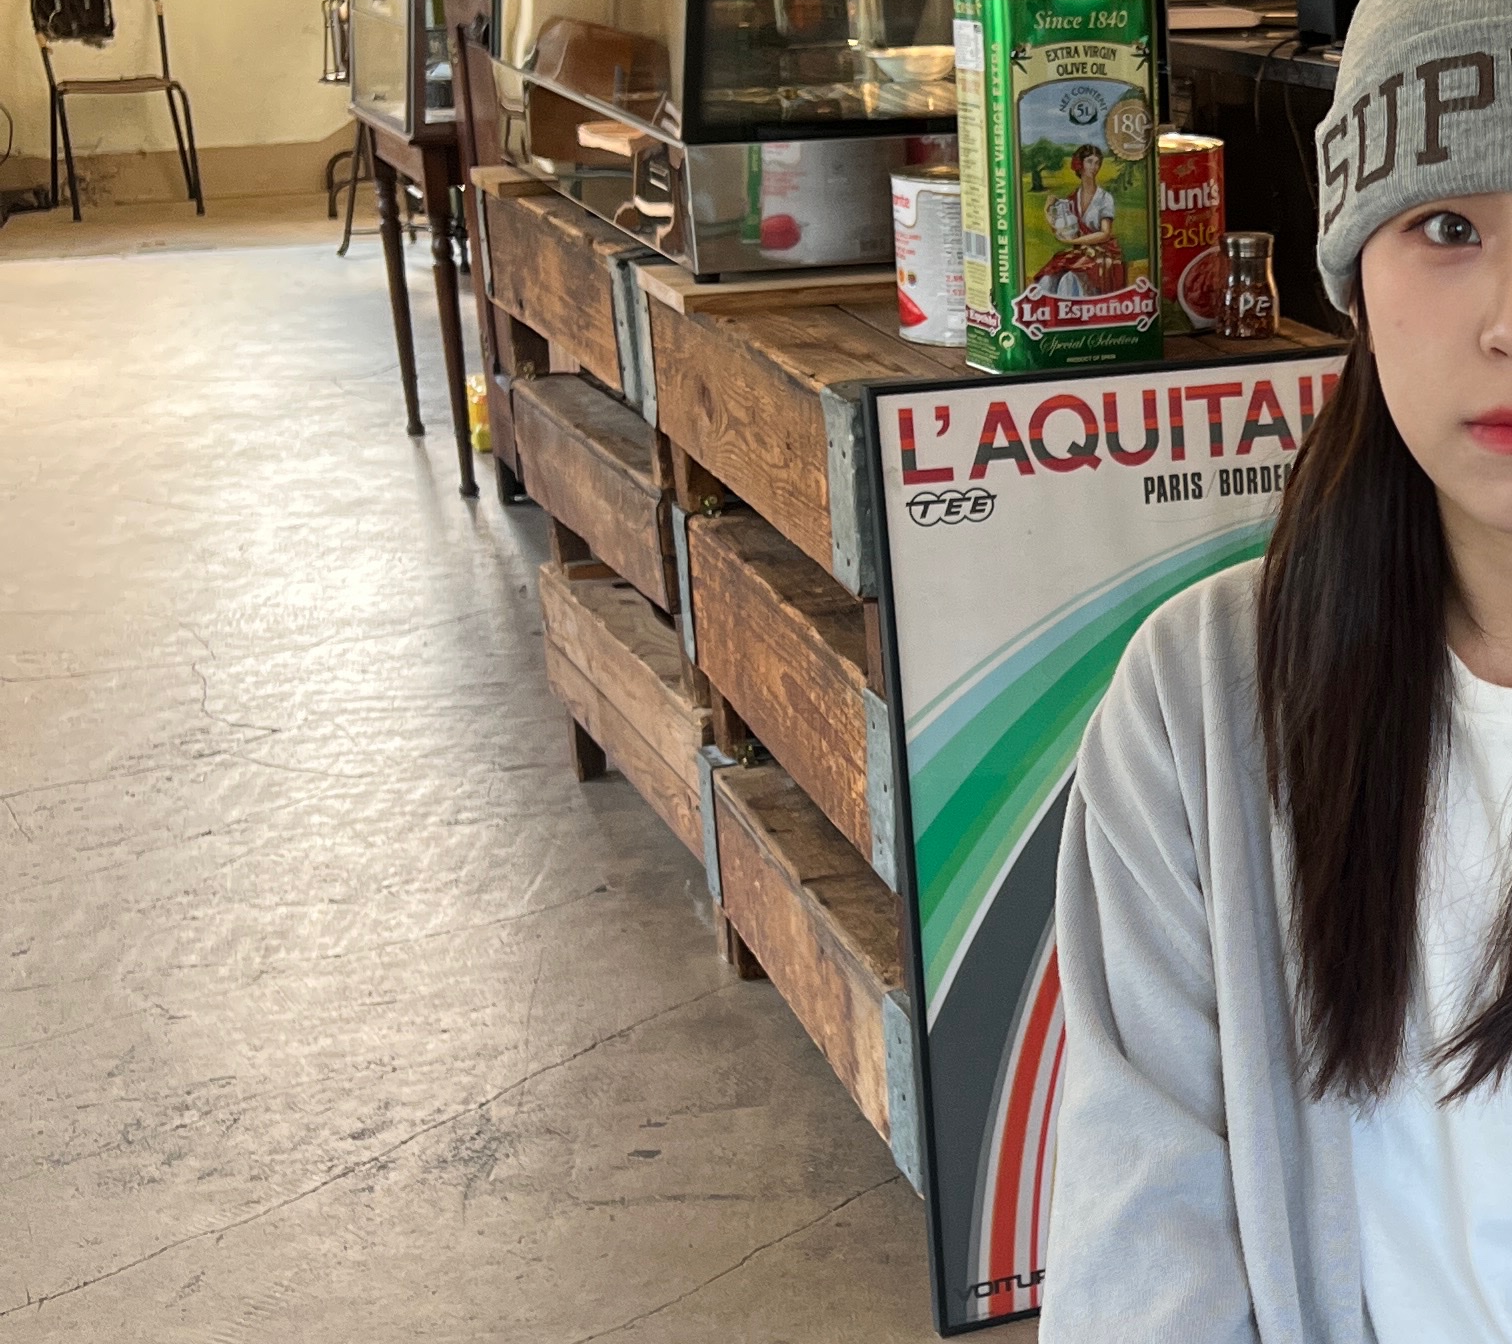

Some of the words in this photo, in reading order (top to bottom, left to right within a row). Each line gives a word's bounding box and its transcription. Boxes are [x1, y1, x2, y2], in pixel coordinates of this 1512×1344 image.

[1033, 10, 1083, 29] Since
[1087, 9, 1129, 29] 1840
[1045, 45, 1080, 63] EXTRA
[1083, 45, 1117, 62] VIRGIN
[1056, 62, 1088, 77] OLIVE
[1090, 61, 1107, 76] OIL
[1070, 85, 1108, 112] CONTENT
[995, 166, 1008, 229] D'OLIVE
[998, 234, 1011, 284] HUILE
[1022, 303, 1051, 322] La
[1058, 295, 1155, 322] Española
[1039, 334, 1086, 357] Special
[1143, 475, 1204, 505] PARIS
[906, 488, 998, 524] TEE
